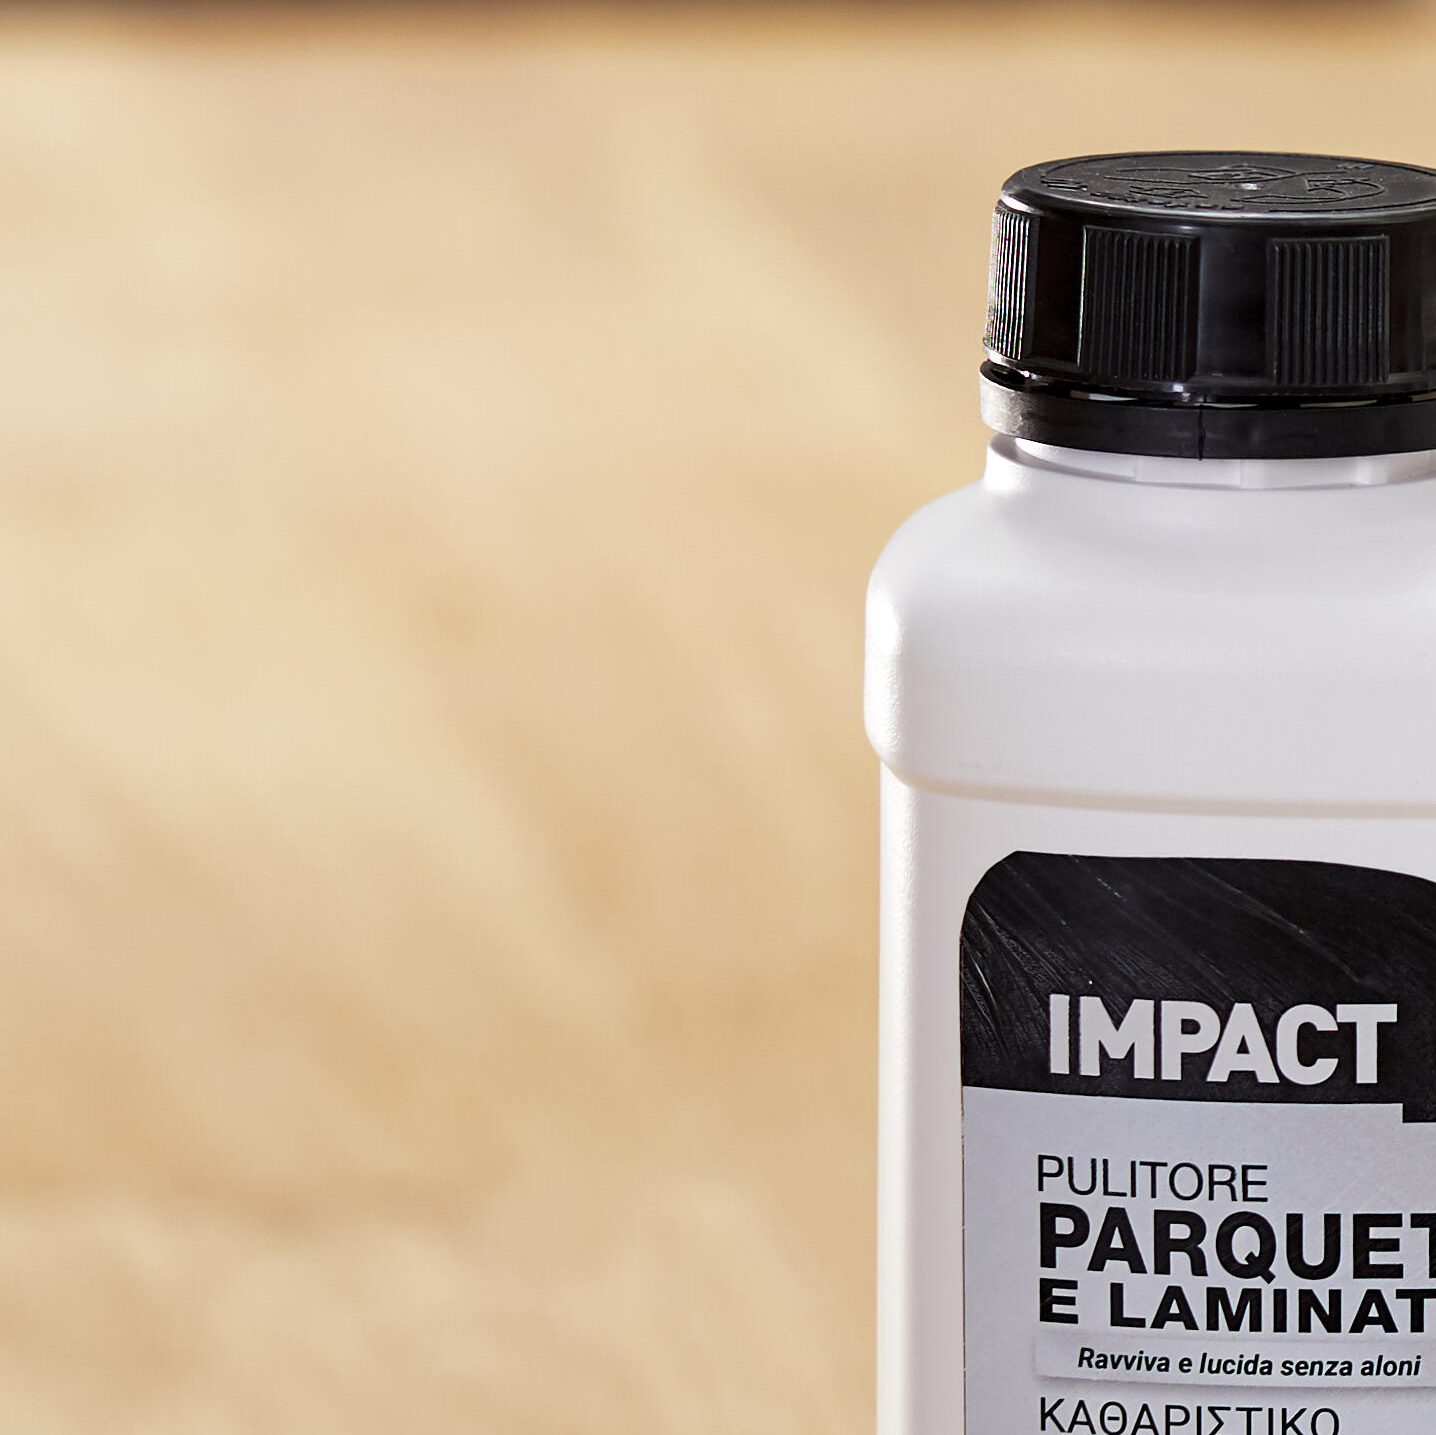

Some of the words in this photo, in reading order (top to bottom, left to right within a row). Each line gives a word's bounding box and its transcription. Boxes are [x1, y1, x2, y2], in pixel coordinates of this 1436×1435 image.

[1049, 993, 1398, 1086] IMPACT
[1037, 1154, 1269, 1203] PULITORE
[1038, 1277, 1080, 1325] E
[1077, 1347, 1171, 1374] Ravviva
[1178, 1354, 1193, 1374] e
[1199, 1352, 1274, 1377] lucida
[1280, 1357, 1353, 1378] senza
[1360, 1353, 1422, 1378] aloni
